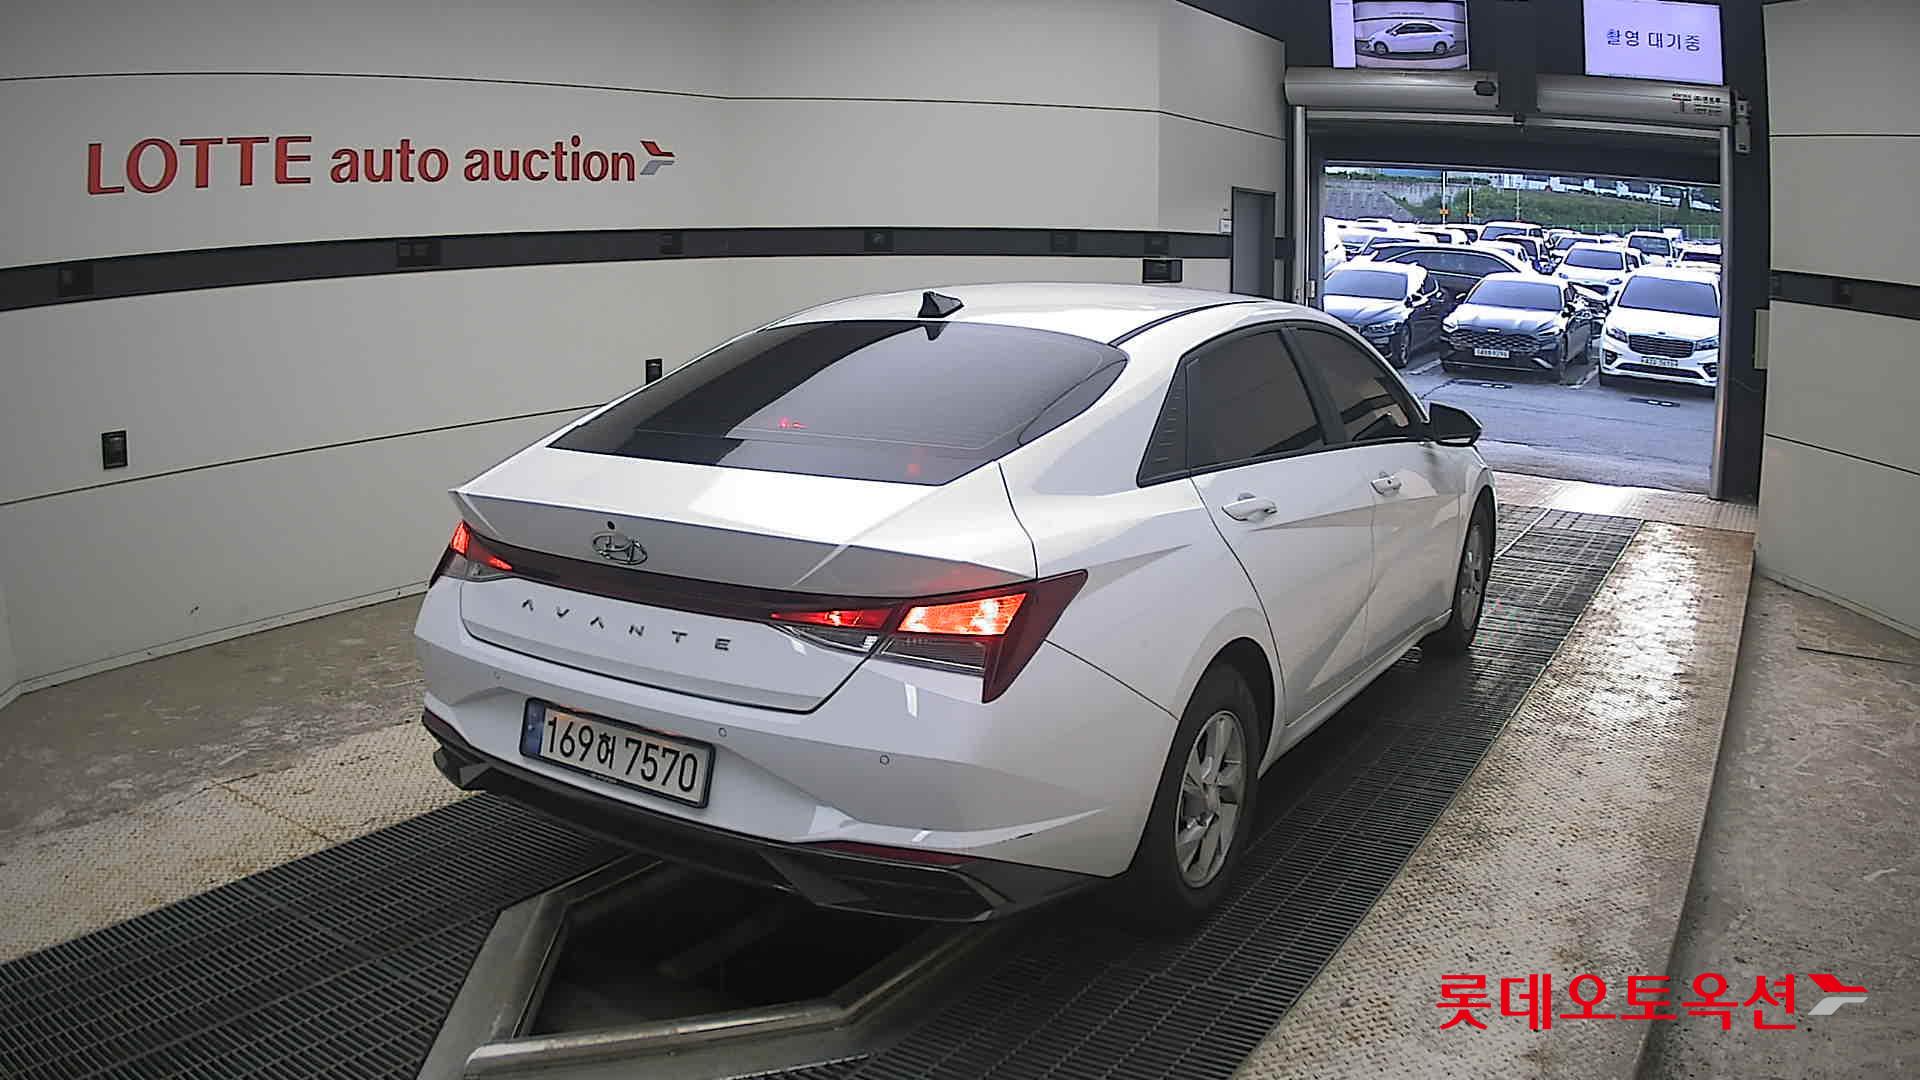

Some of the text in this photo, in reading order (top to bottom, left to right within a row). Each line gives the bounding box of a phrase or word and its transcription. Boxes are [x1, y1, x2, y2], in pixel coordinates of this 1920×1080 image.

[1606, 28, 1701, 52] 촬영 대기중
[87, 135, 637, 196] LOTTE auto auction
[521, 598, 732, 652] AVANTE
[624, 737, 698, 793] 7570
